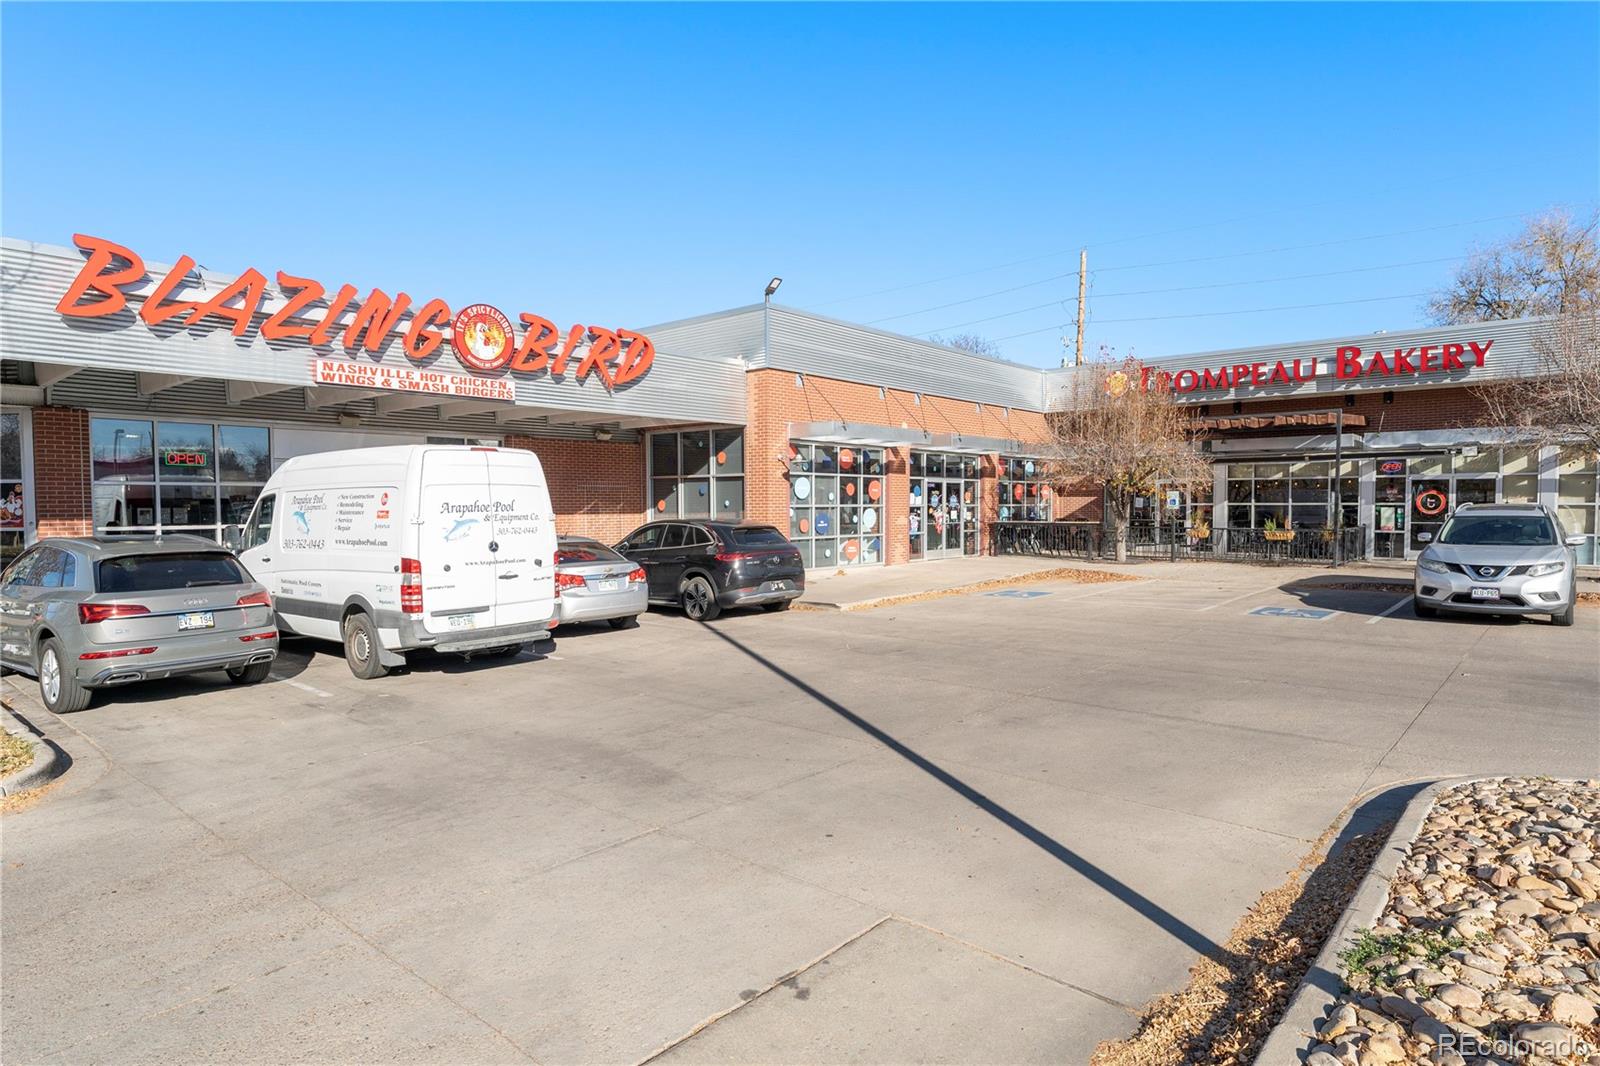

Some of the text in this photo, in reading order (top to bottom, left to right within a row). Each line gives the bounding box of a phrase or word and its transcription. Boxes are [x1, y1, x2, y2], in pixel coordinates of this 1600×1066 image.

[56, 233, 656, 388] BLAZING BIRD
[467, 305, 512, 338] SPICYLICIOUS
[322, 362, 415, 380] NASHVILLE
[420, 373, 446, 384] HOT
[1141, 340, 1494, 395] TROMPEAU BAKERY
[320, 372, 513, 399] WINGS & SMASH BURGERS
[167, 453, 205, 464] OPEN
[1381, 462, 1402, 472] OPEN
[440, 499, 516, 519] Arapahoe Pool
[483, 513, 491, 522] &
[493, 512, 529, 525] Equipment
[496, 526, 538, 536] 303-762-0443
